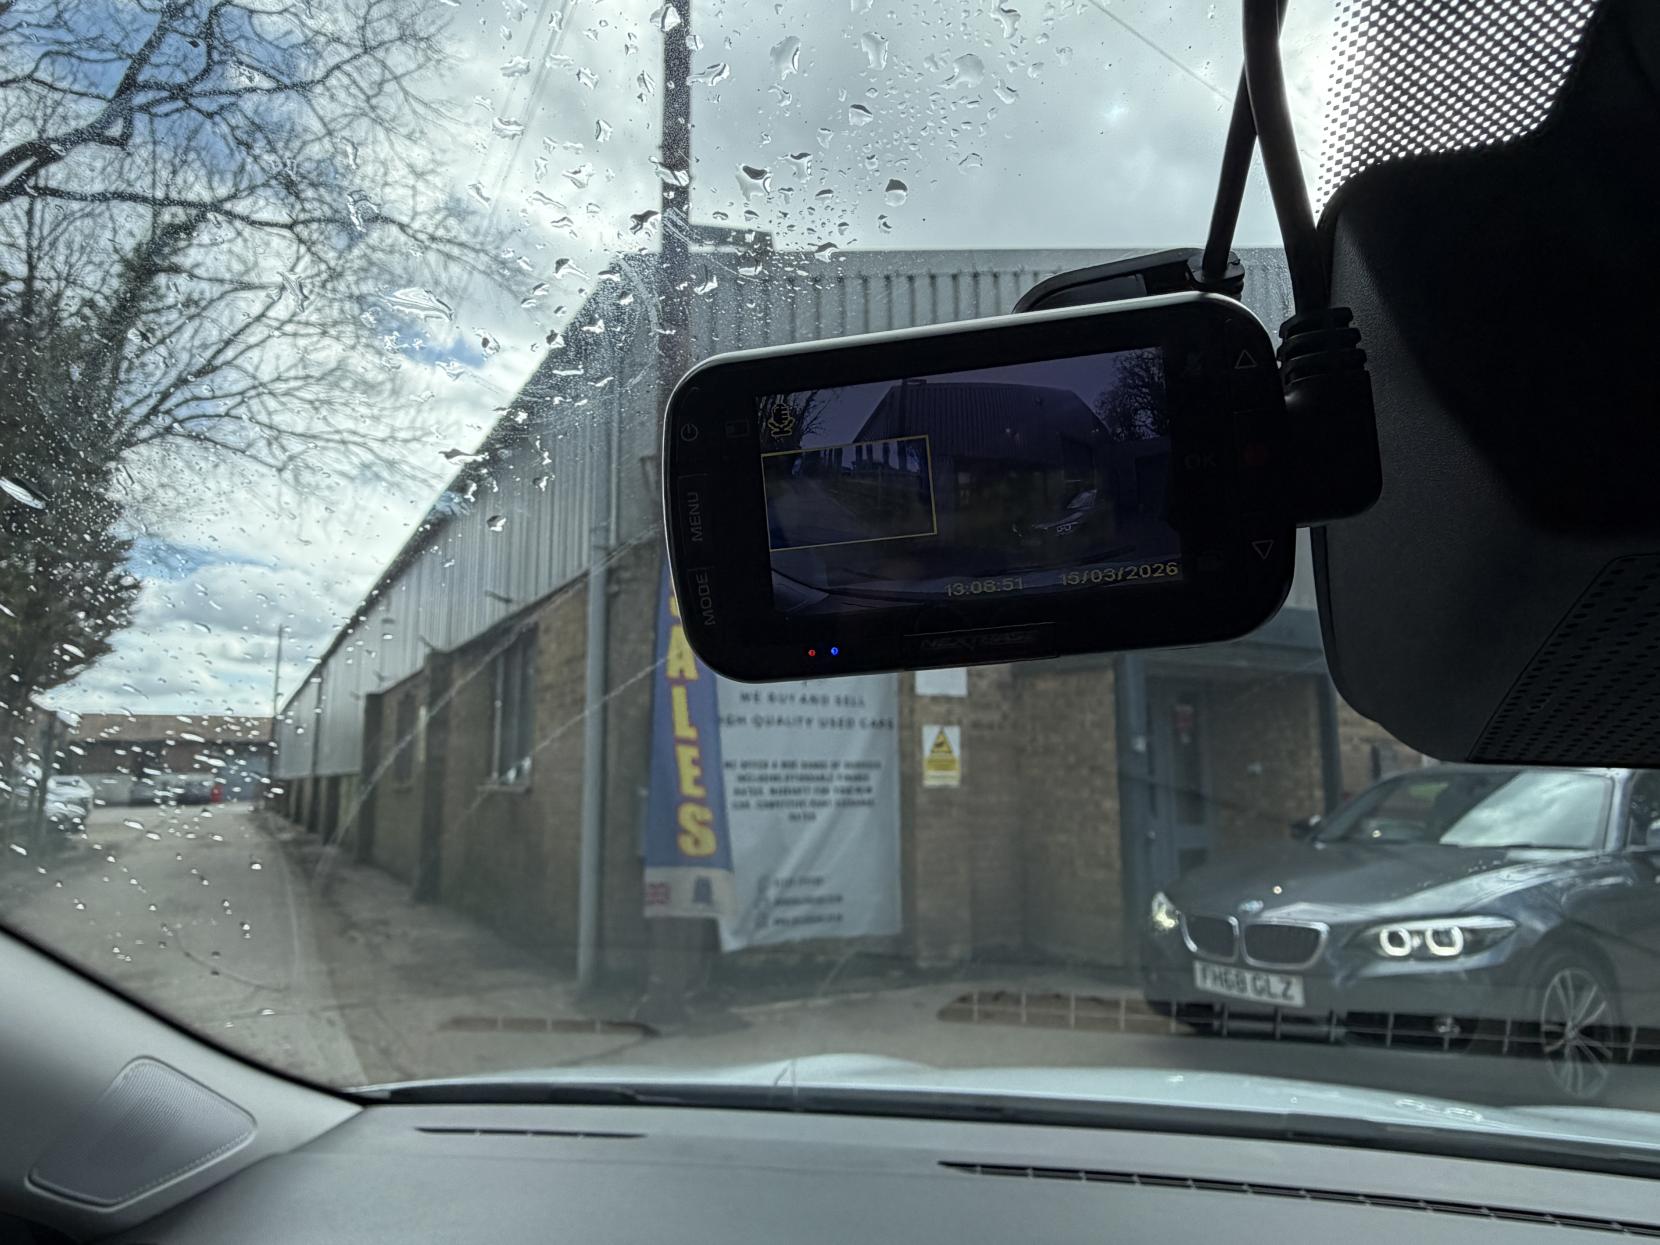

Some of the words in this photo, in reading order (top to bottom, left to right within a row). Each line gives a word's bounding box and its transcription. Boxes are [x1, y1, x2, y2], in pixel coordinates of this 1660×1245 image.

[687, 491, 704, 542] MENU
[1059, 561, 1179, 586] 15/03/2026
[696, 572, 716, 625] MODE
[739, 690, 762, 703] WE
[767, 691, 796, 704] BUY
[798, 692, 830, 706] AND
[666, 592, 718, 857] ALES
[718, 713, 747, 726] GH
[750, 713, 814, 729] QUALITY
[817, 715, 857, 730] USED
[859, 716, 895, 730] CARS
